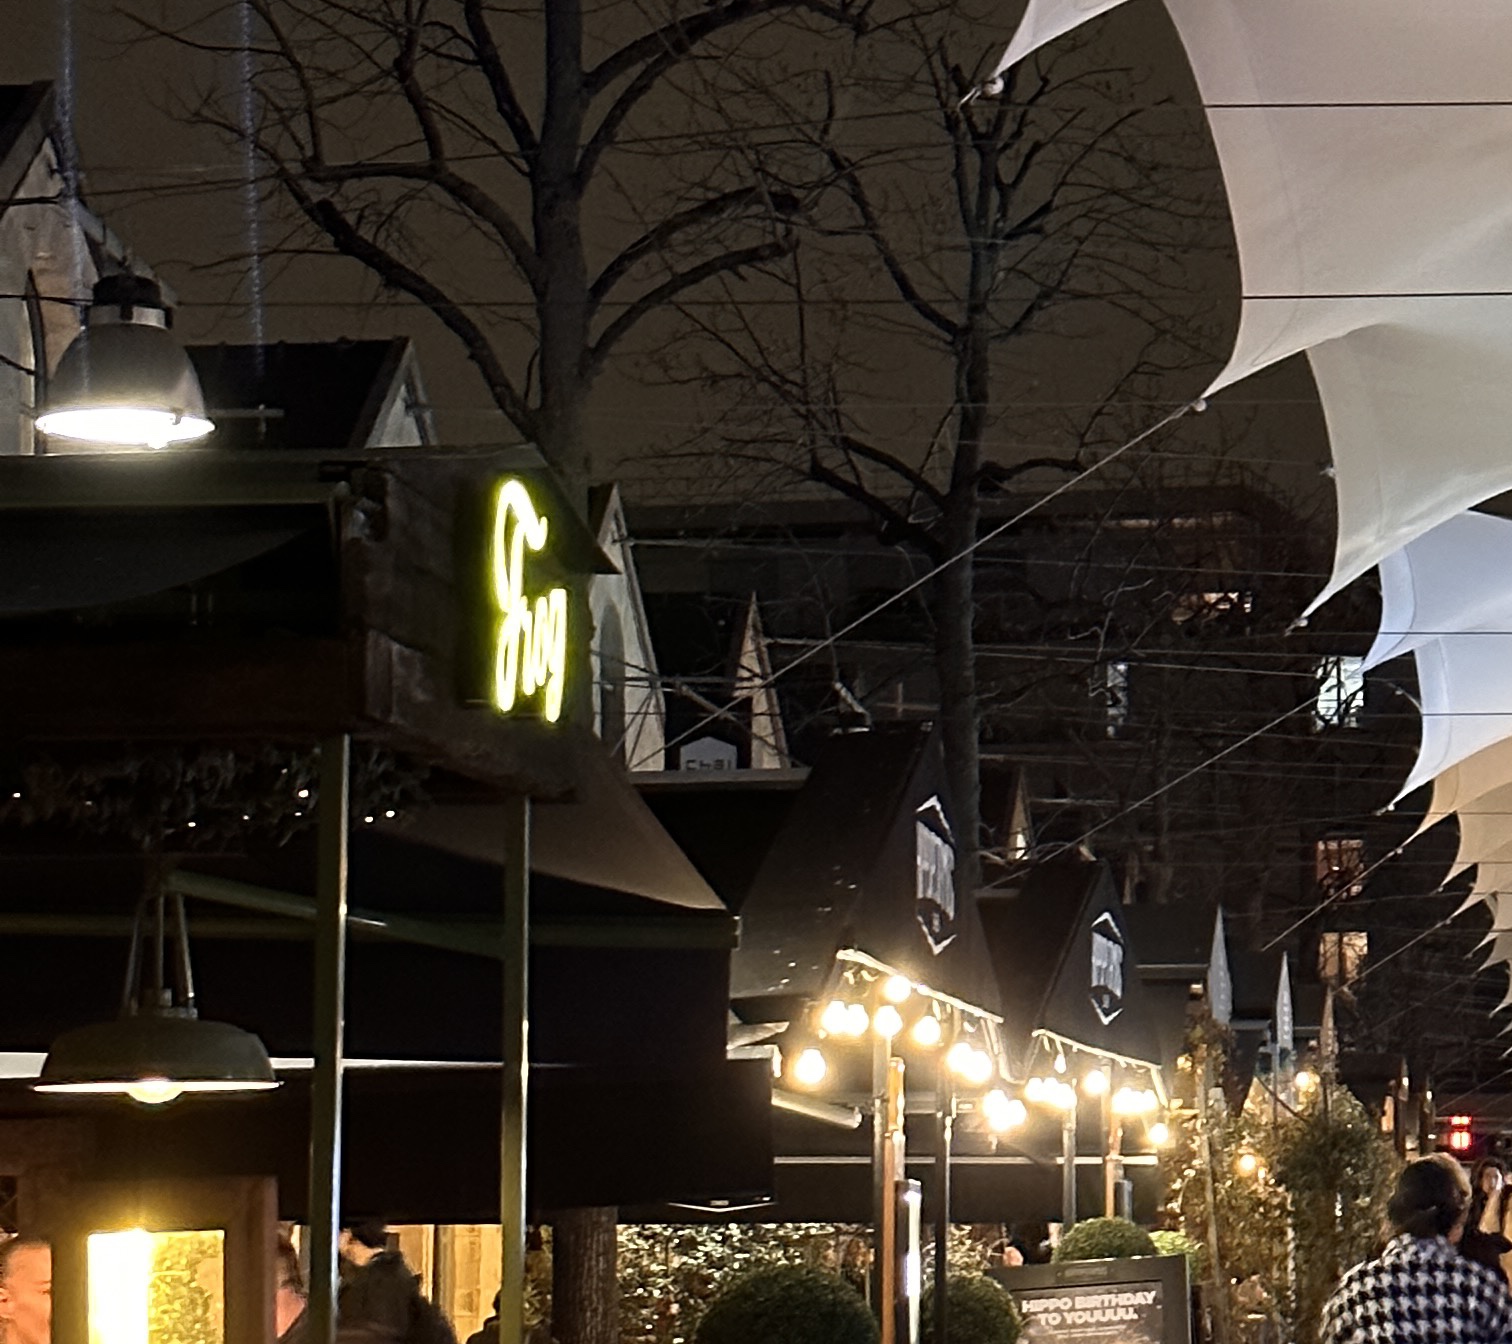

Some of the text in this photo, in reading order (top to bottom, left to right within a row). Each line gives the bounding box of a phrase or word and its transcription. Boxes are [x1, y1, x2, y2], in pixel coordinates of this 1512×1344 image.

[1022, 1290, 1156, 1313] HIPPO BIRTHDAY
[1038, 1312, 1061, 1326] TO
